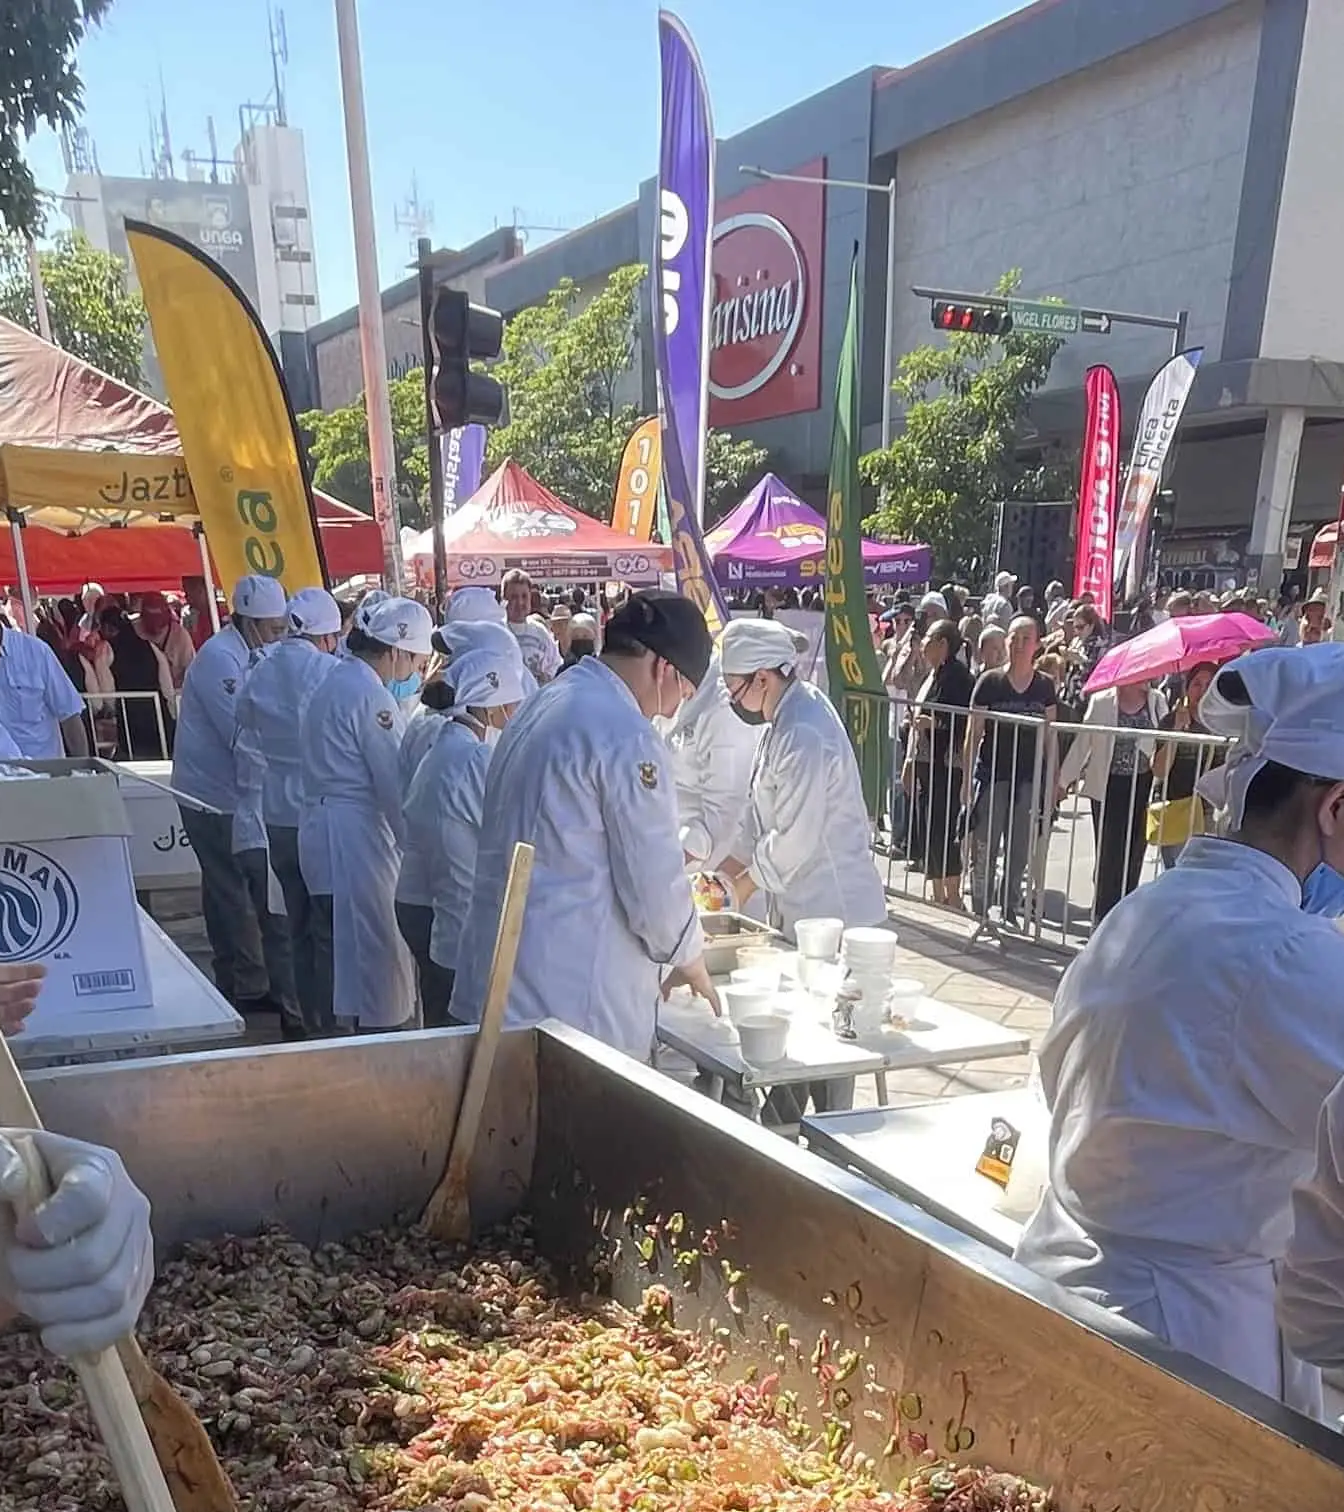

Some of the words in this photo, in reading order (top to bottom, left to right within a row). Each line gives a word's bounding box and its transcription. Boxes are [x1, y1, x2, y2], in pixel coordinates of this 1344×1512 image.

[98, 467, 193, 504] Jazt
[458, 555, 496, 580] exa
[615, 553, 650, 576] exa
